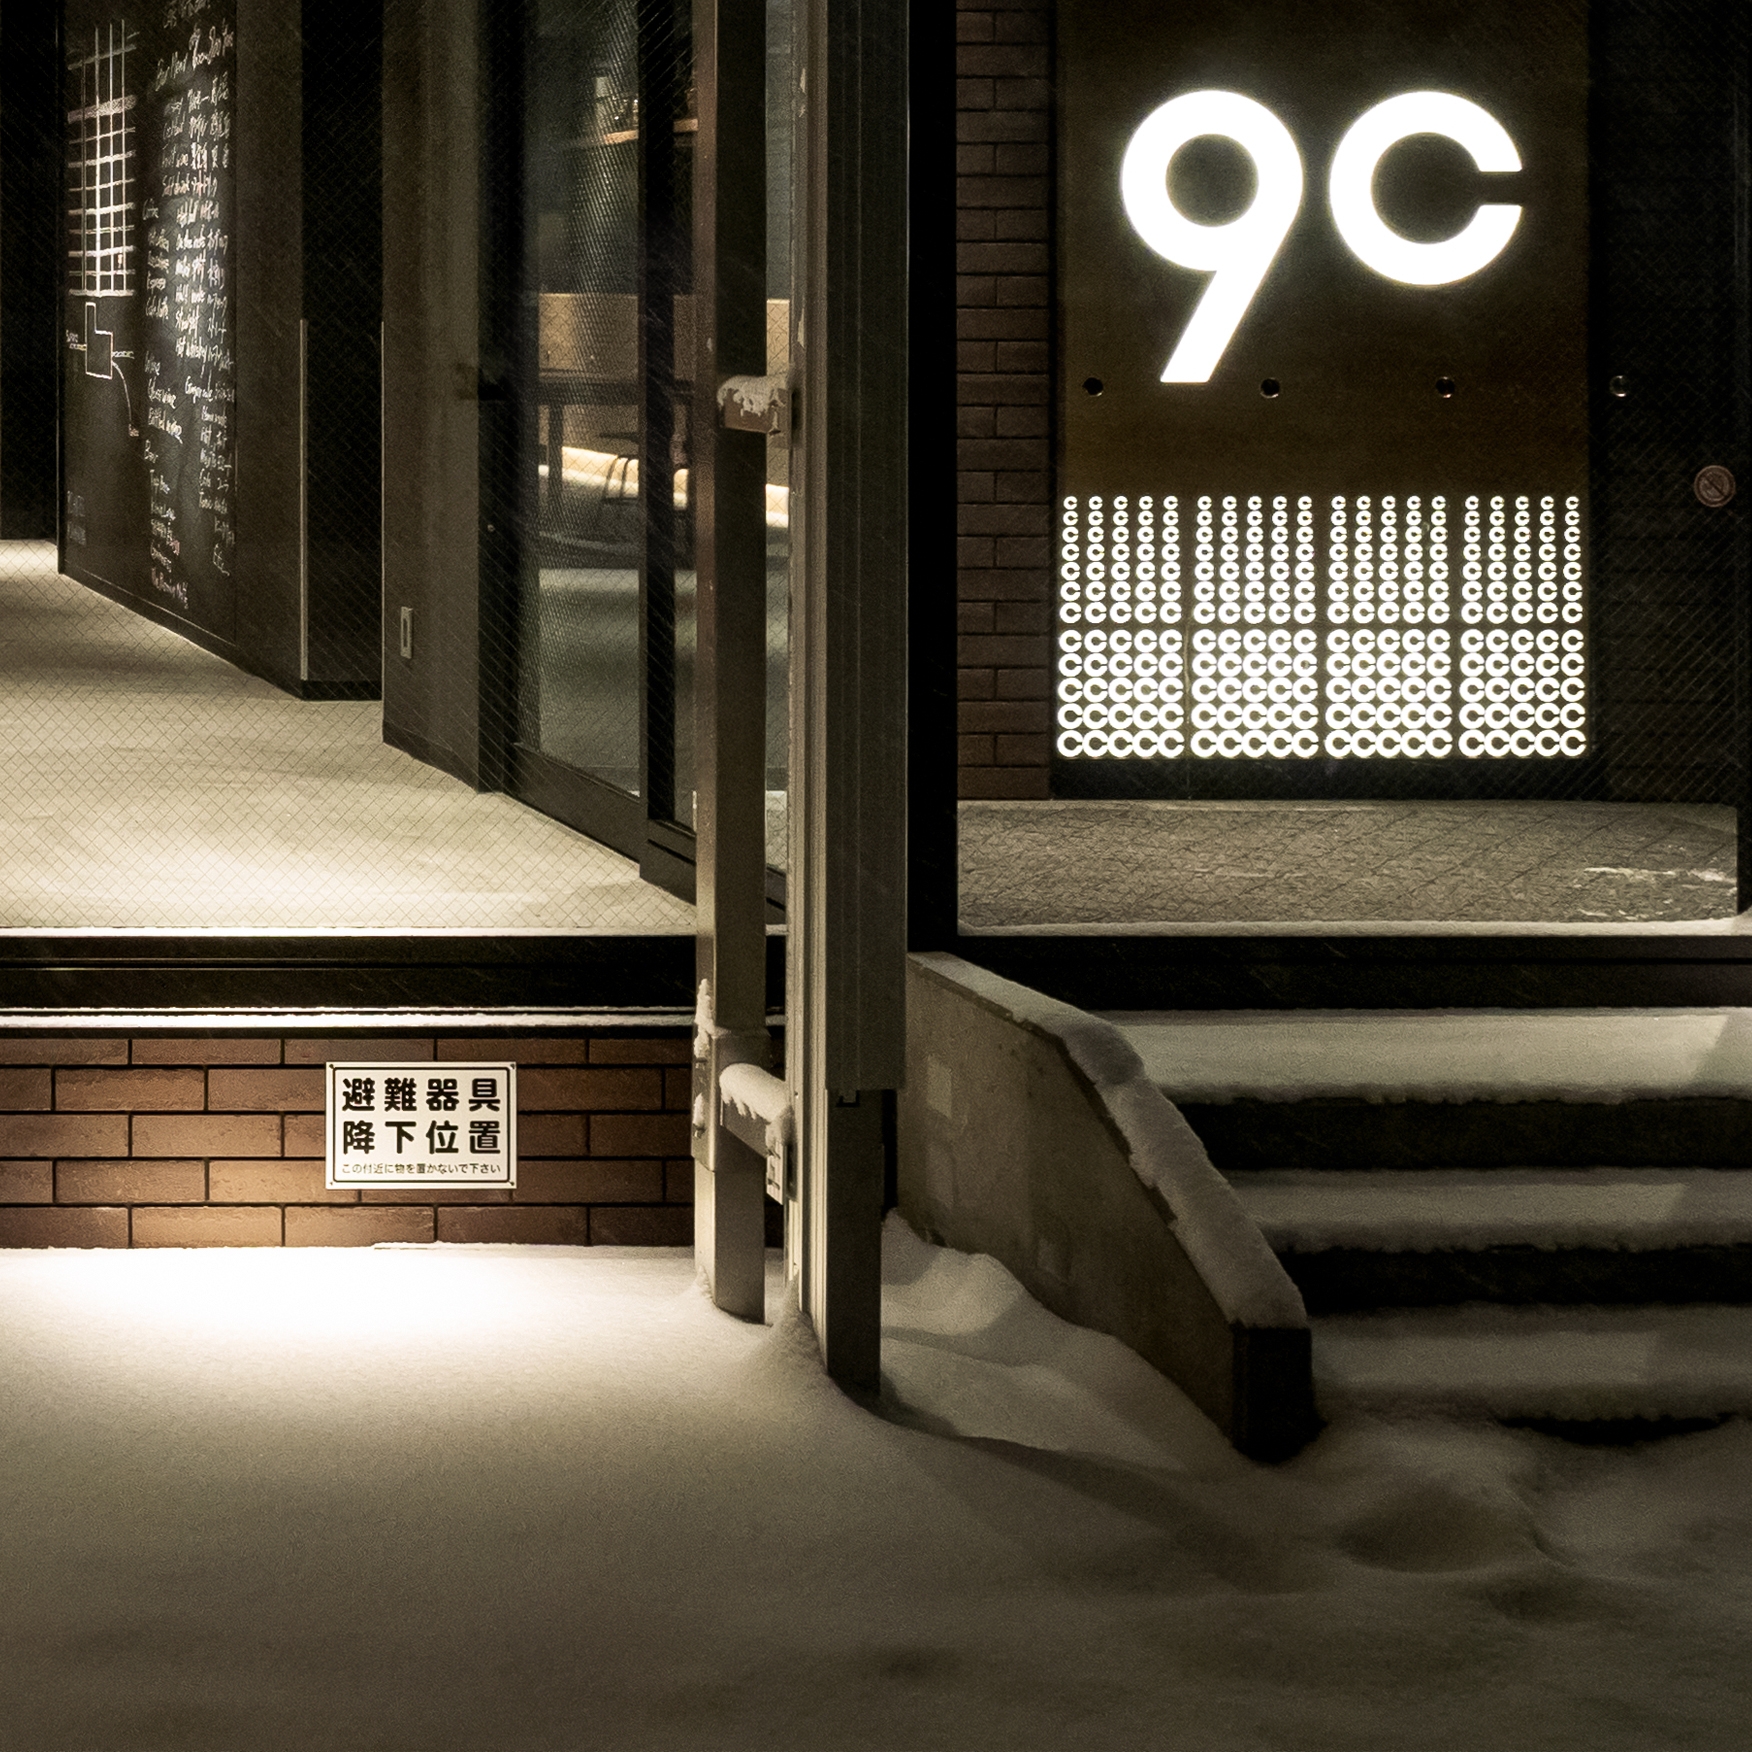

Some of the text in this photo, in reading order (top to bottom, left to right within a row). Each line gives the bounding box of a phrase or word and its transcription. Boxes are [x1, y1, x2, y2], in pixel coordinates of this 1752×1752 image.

[342, 1077, 501, 1112] 避難器具
[342, 1120, 501, 1155] 降下位置
[342, 1162, 501, 1175] この付近に物を置かないで下さい
